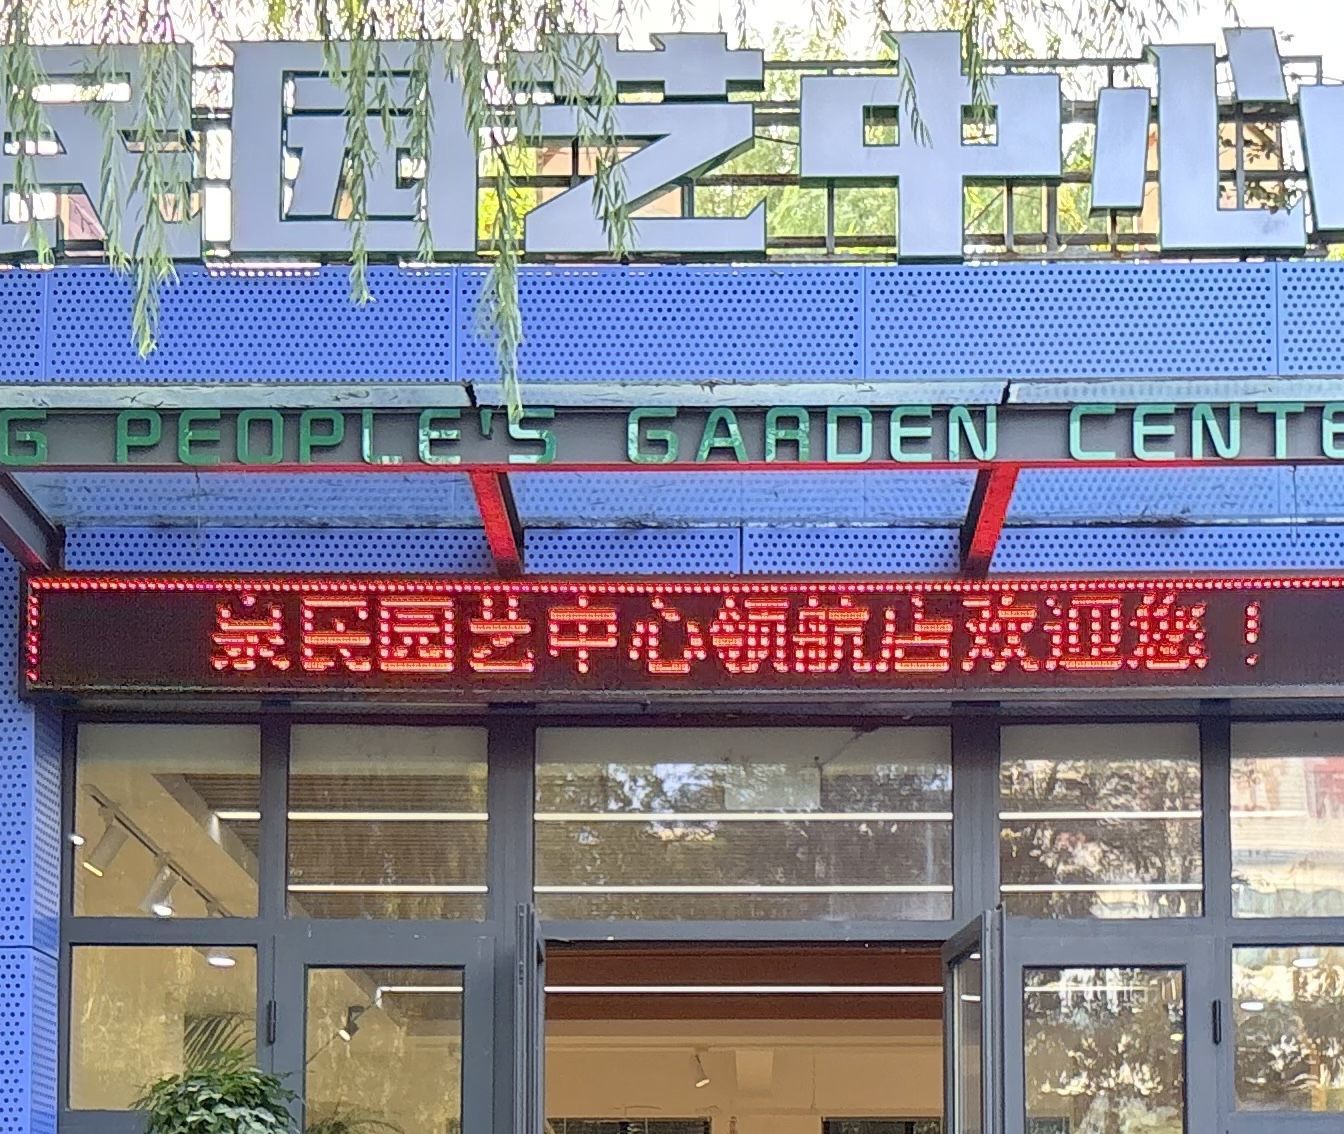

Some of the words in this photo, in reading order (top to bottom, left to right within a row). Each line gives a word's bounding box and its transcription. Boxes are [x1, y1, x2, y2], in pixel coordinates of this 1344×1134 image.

[115, 406, 558, 466] PEOPLE'S
[626, 405, 998, 464] GARDEN
[212, 594, 1261, 676] 泉民园艺中心领航店欢迎您！
